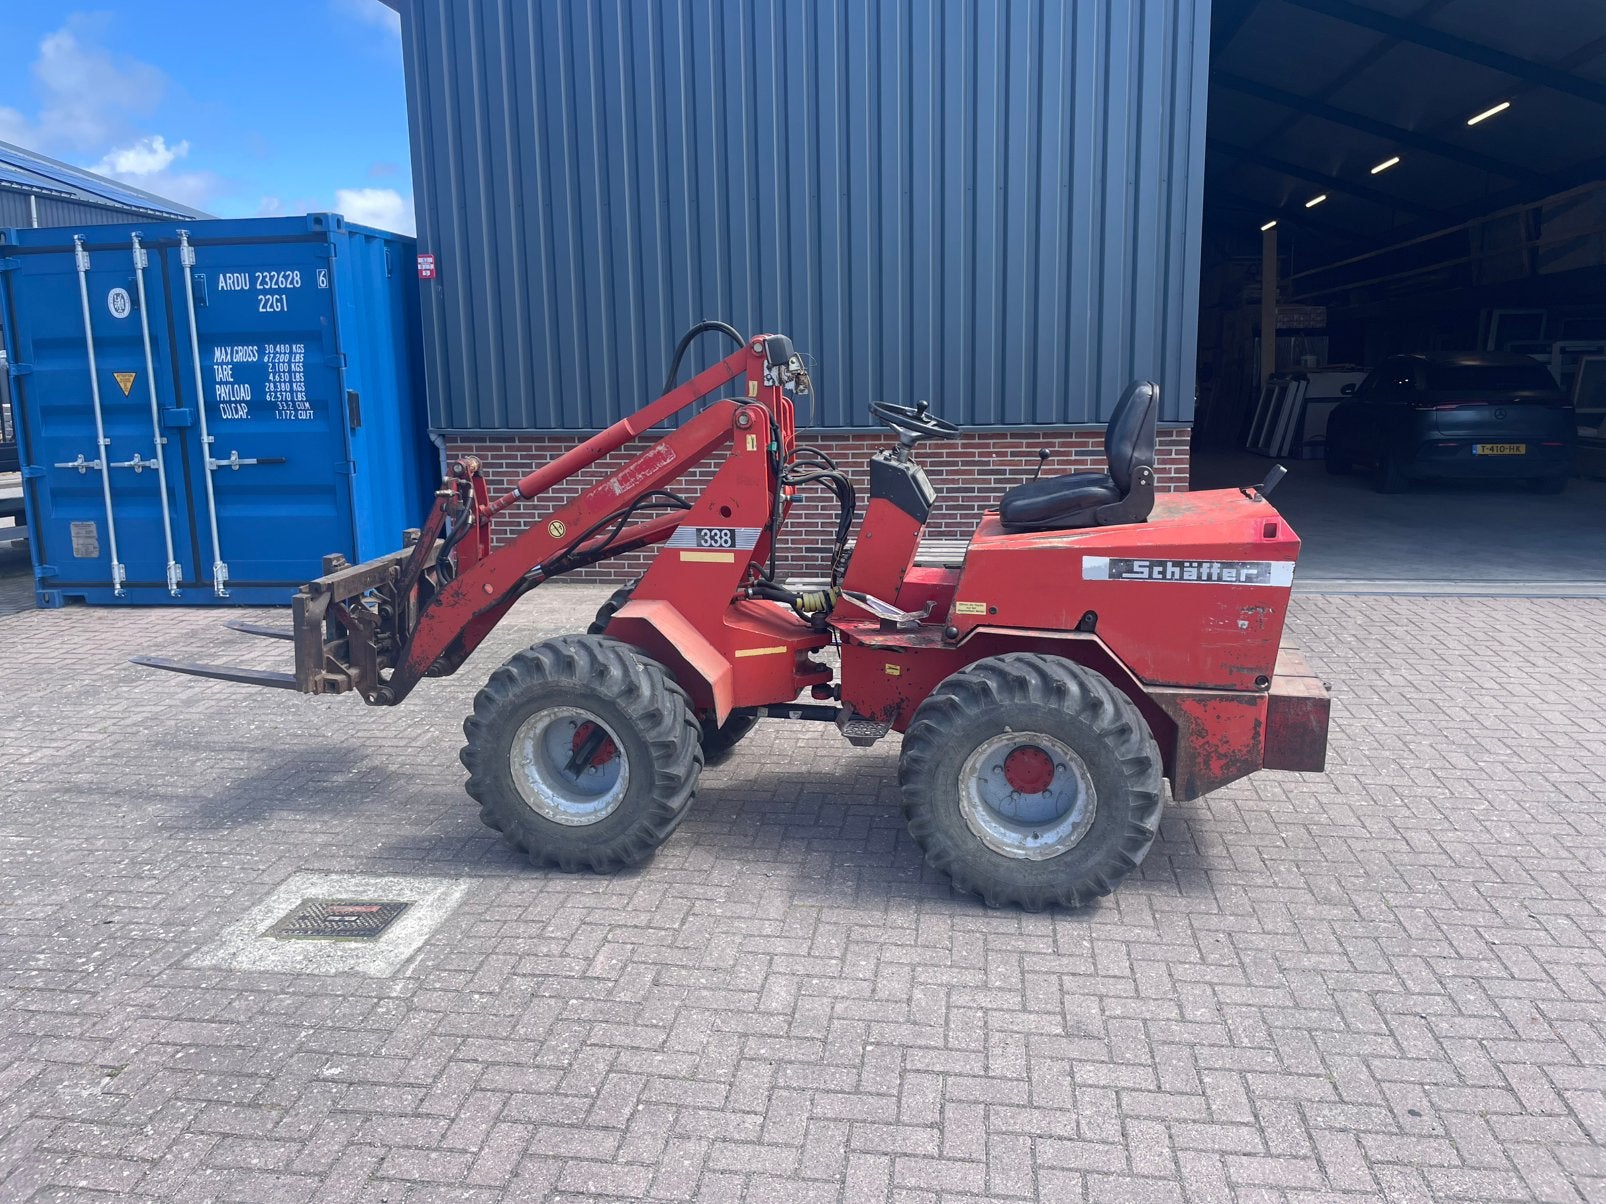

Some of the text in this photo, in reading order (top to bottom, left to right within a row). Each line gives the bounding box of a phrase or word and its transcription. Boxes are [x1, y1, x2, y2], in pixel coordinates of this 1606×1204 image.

[218, 270, 327, 291] ARDU 232628 6
[257, 294, 288, 312] 22G1
[264, 344, 305, 353] 30.480 KGS
[213, 345, 258, 363] MAX GROSS
[263, 354, 305, 363] 67.200 LBS
[268, 363, 304, 372] 2.100 KGS
[213, 364, 234, 382] TARE
[268, 372, 305, 381] 4.630 LBS
[215, 383, 252, 401] PAYLOAD
[264, 382, 306, 392] 28.380 KGS
[266, 392, 307, 401] 62.570 LBS
[277, 401, 294, 410] 33.2
[275, 410, 296, 419] 1.172
[700, 529, 732, 548] 338
[1121, 560, 1258, 582] Schäffer
